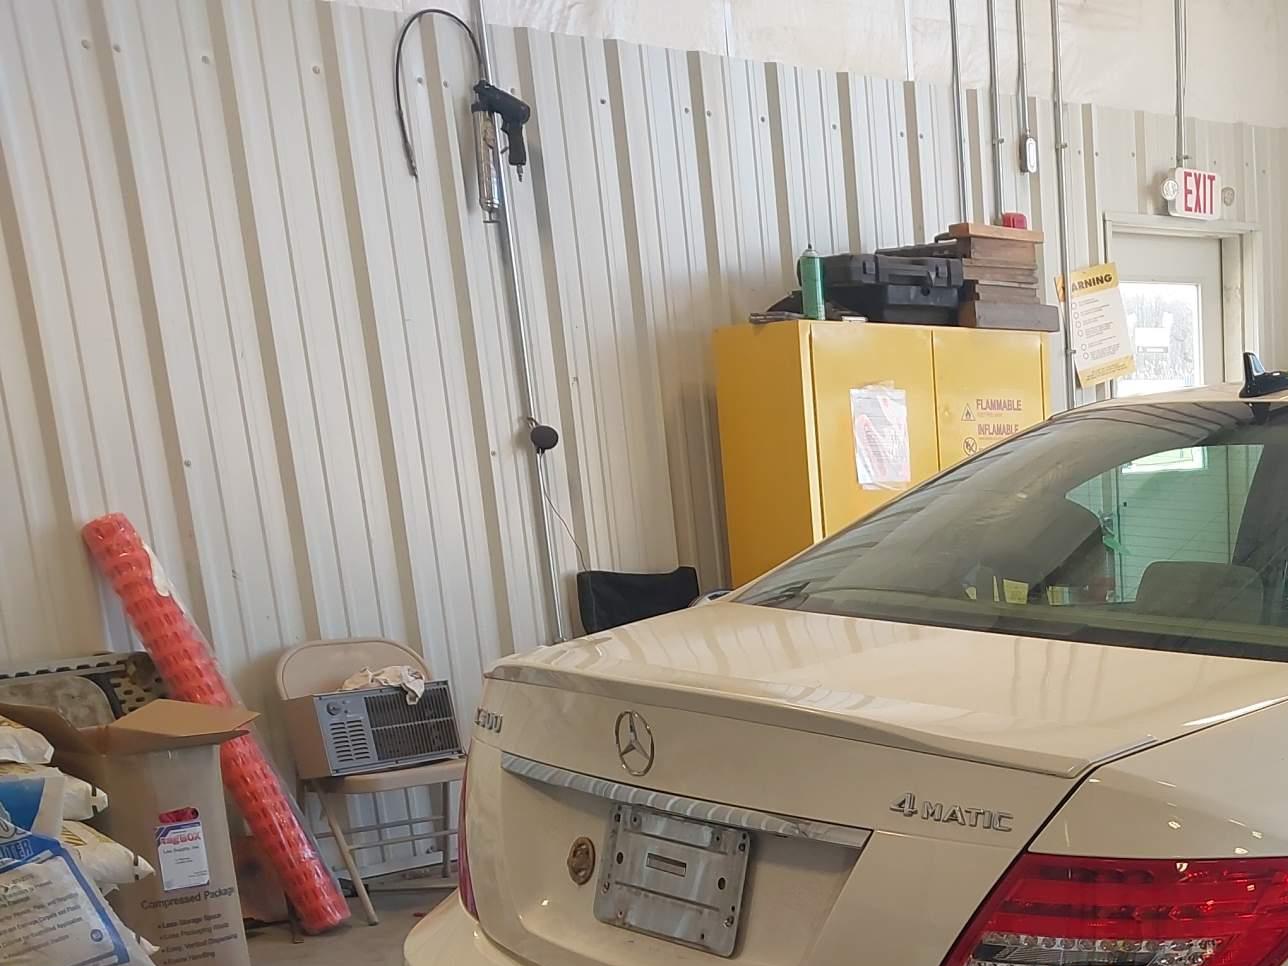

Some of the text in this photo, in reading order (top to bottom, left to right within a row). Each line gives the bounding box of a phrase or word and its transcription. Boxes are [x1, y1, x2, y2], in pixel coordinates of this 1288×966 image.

[1184, 171, 1216, 215] EXIT
[1071, 274, 1113, 292] ARNING
[976, 399, 1022, 411] FLAMMABLE
[977, 424, 1019, 436] INFLAMABLE
[141, 892, 200, 910] Compressed
